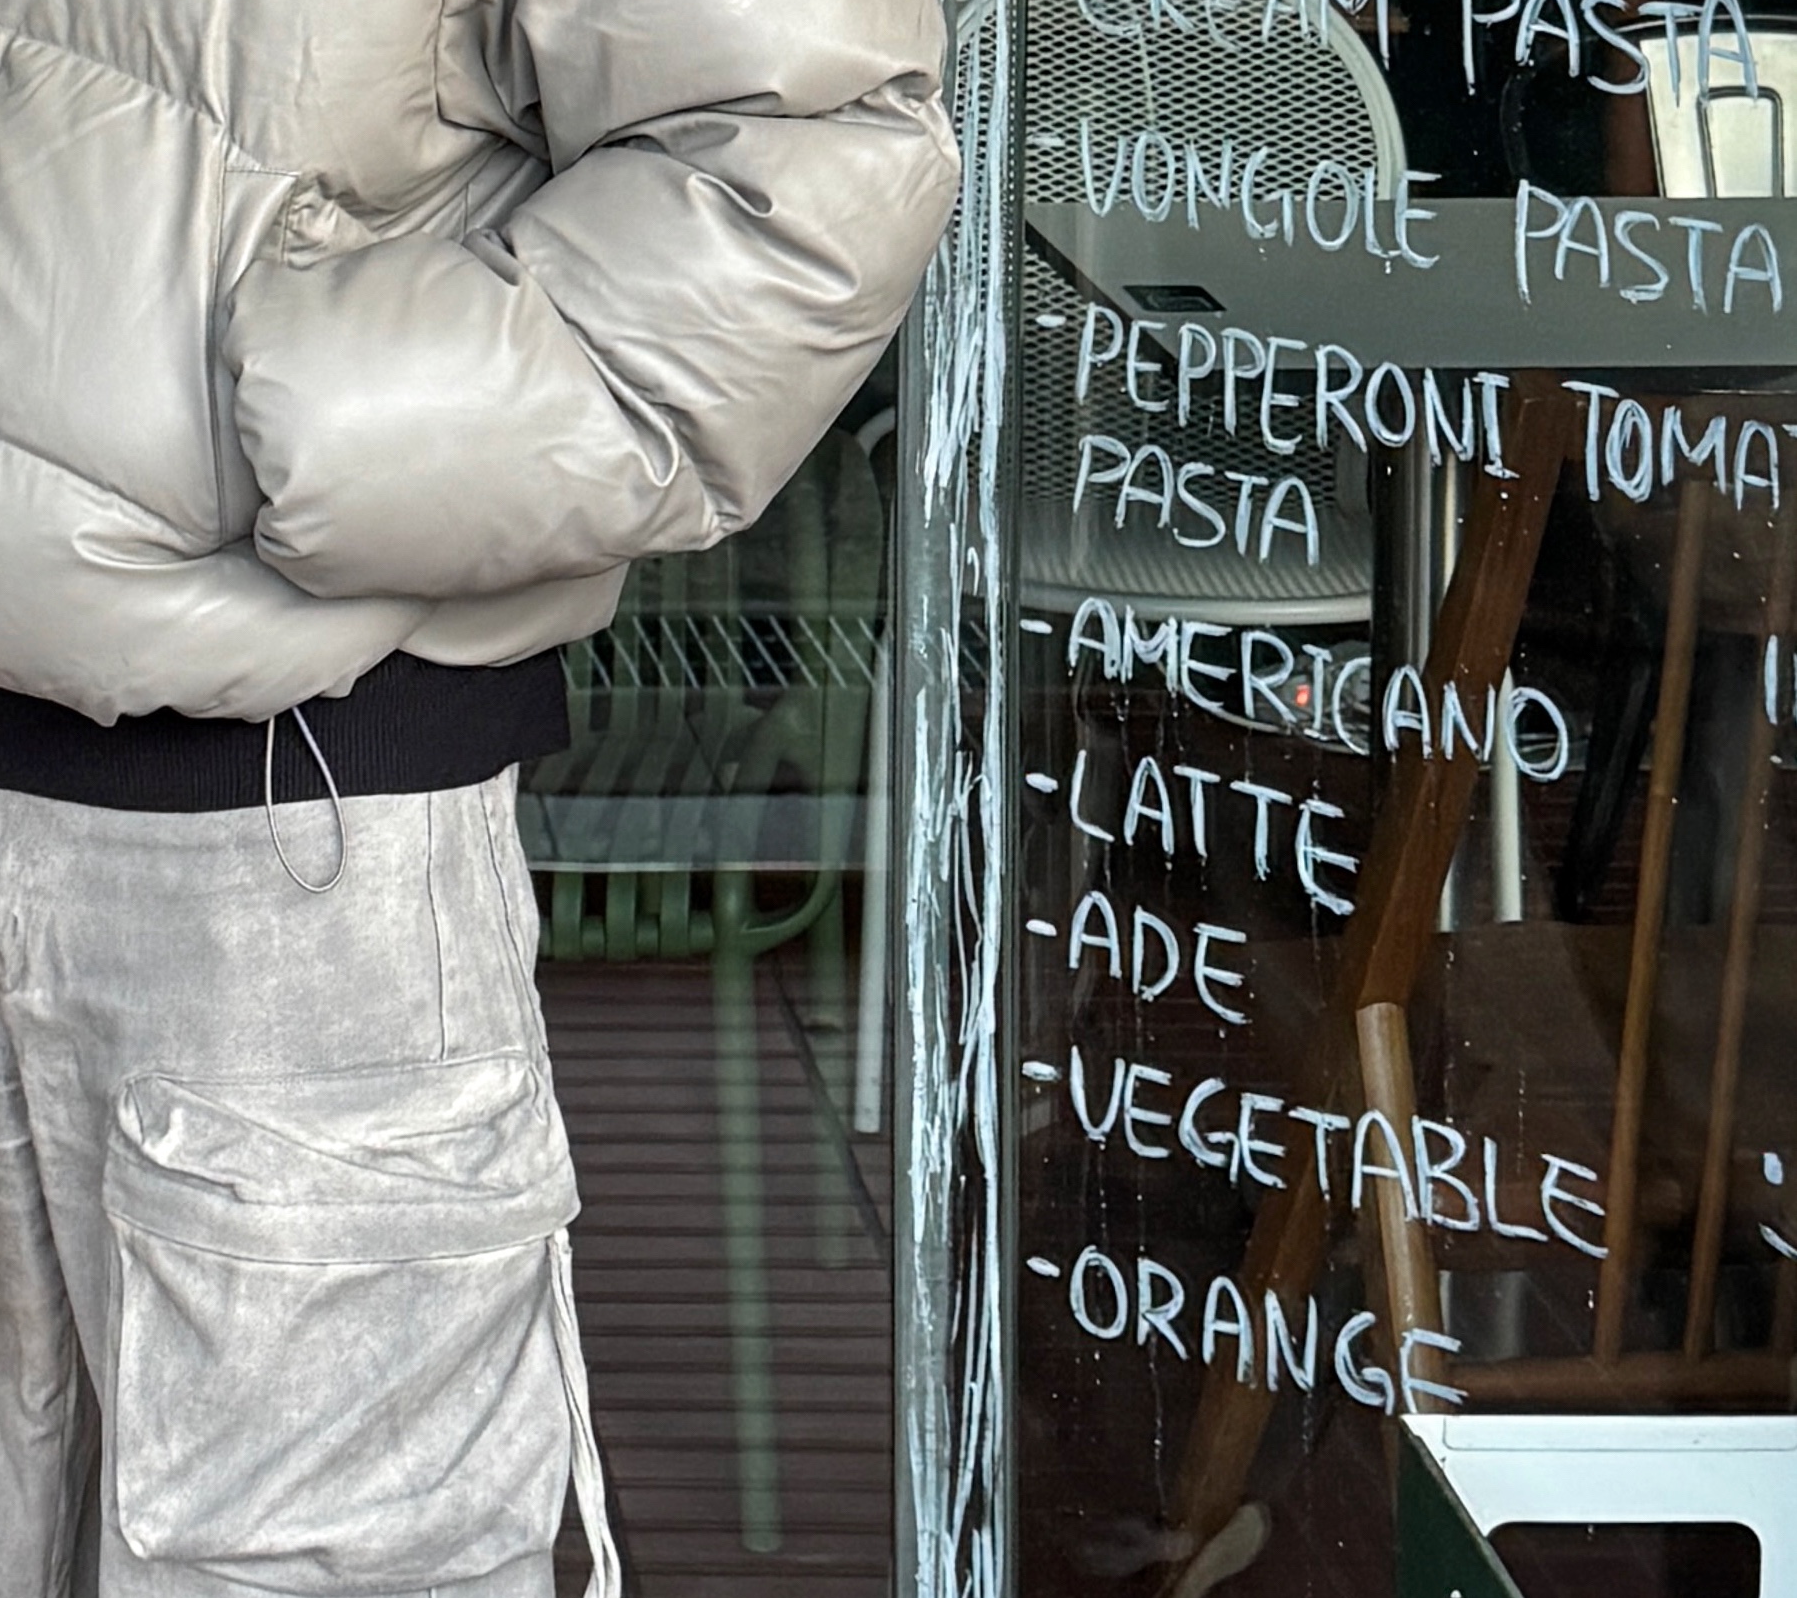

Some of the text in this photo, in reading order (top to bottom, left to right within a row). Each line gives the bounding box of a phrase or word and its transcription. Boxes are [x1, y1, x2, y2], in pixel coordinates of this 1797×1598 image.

[1514, 179, 1782, 313] PASTA
[1073, 435, 1320, 565] PASTA
[1561, 380, 1797, 511] TOMA
